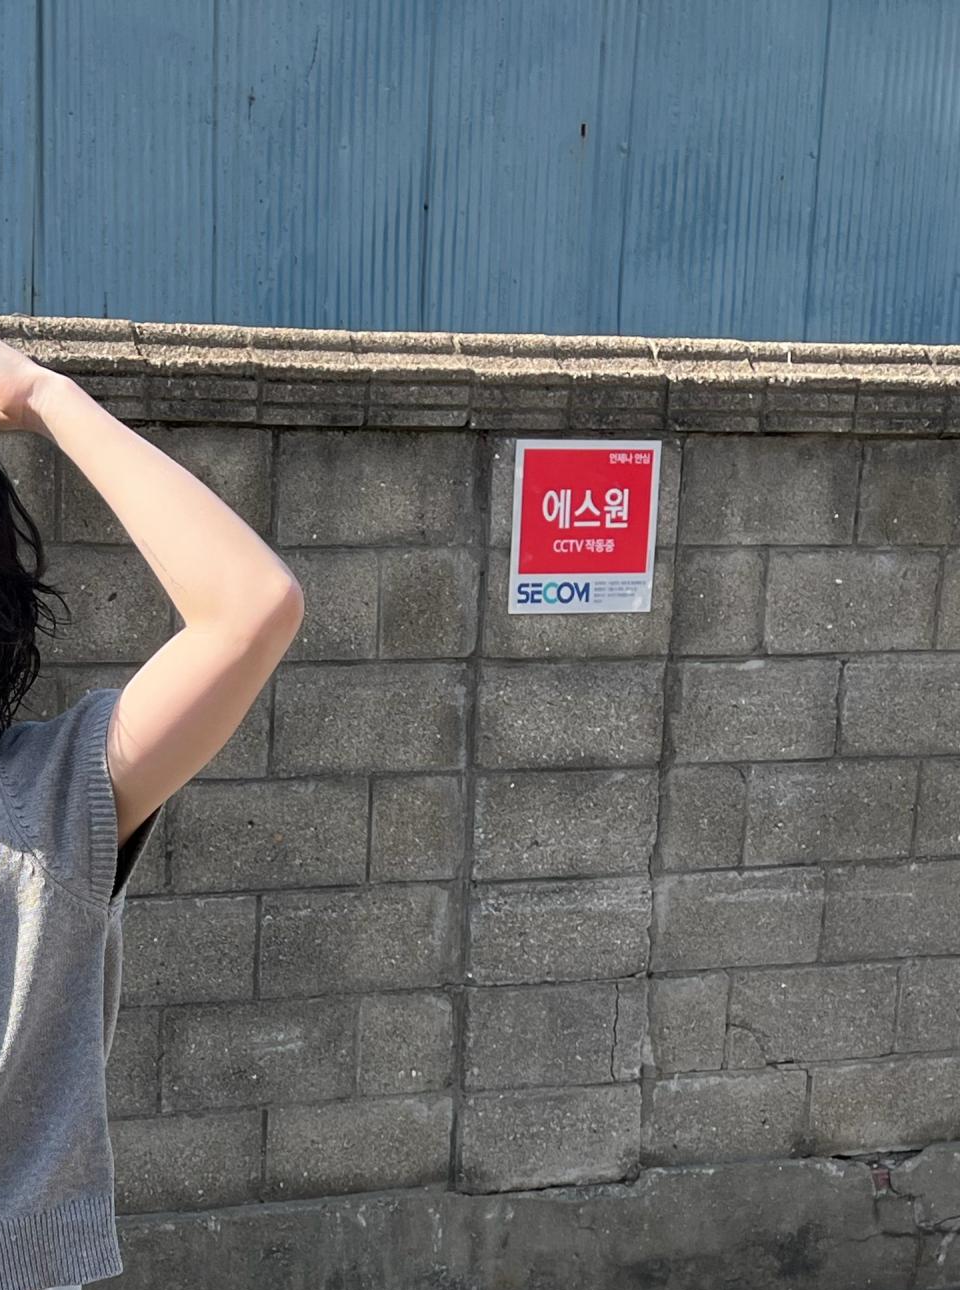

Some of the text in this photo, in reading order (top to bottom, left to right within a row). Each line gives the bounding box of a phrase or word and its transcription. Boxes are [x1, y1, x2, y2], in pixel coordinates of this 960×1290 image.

[542, 488, 629, 529] 에스원
[552, 539, 615, 553] CCTV 작동중
[517, 582, 590, 604] SECOM
